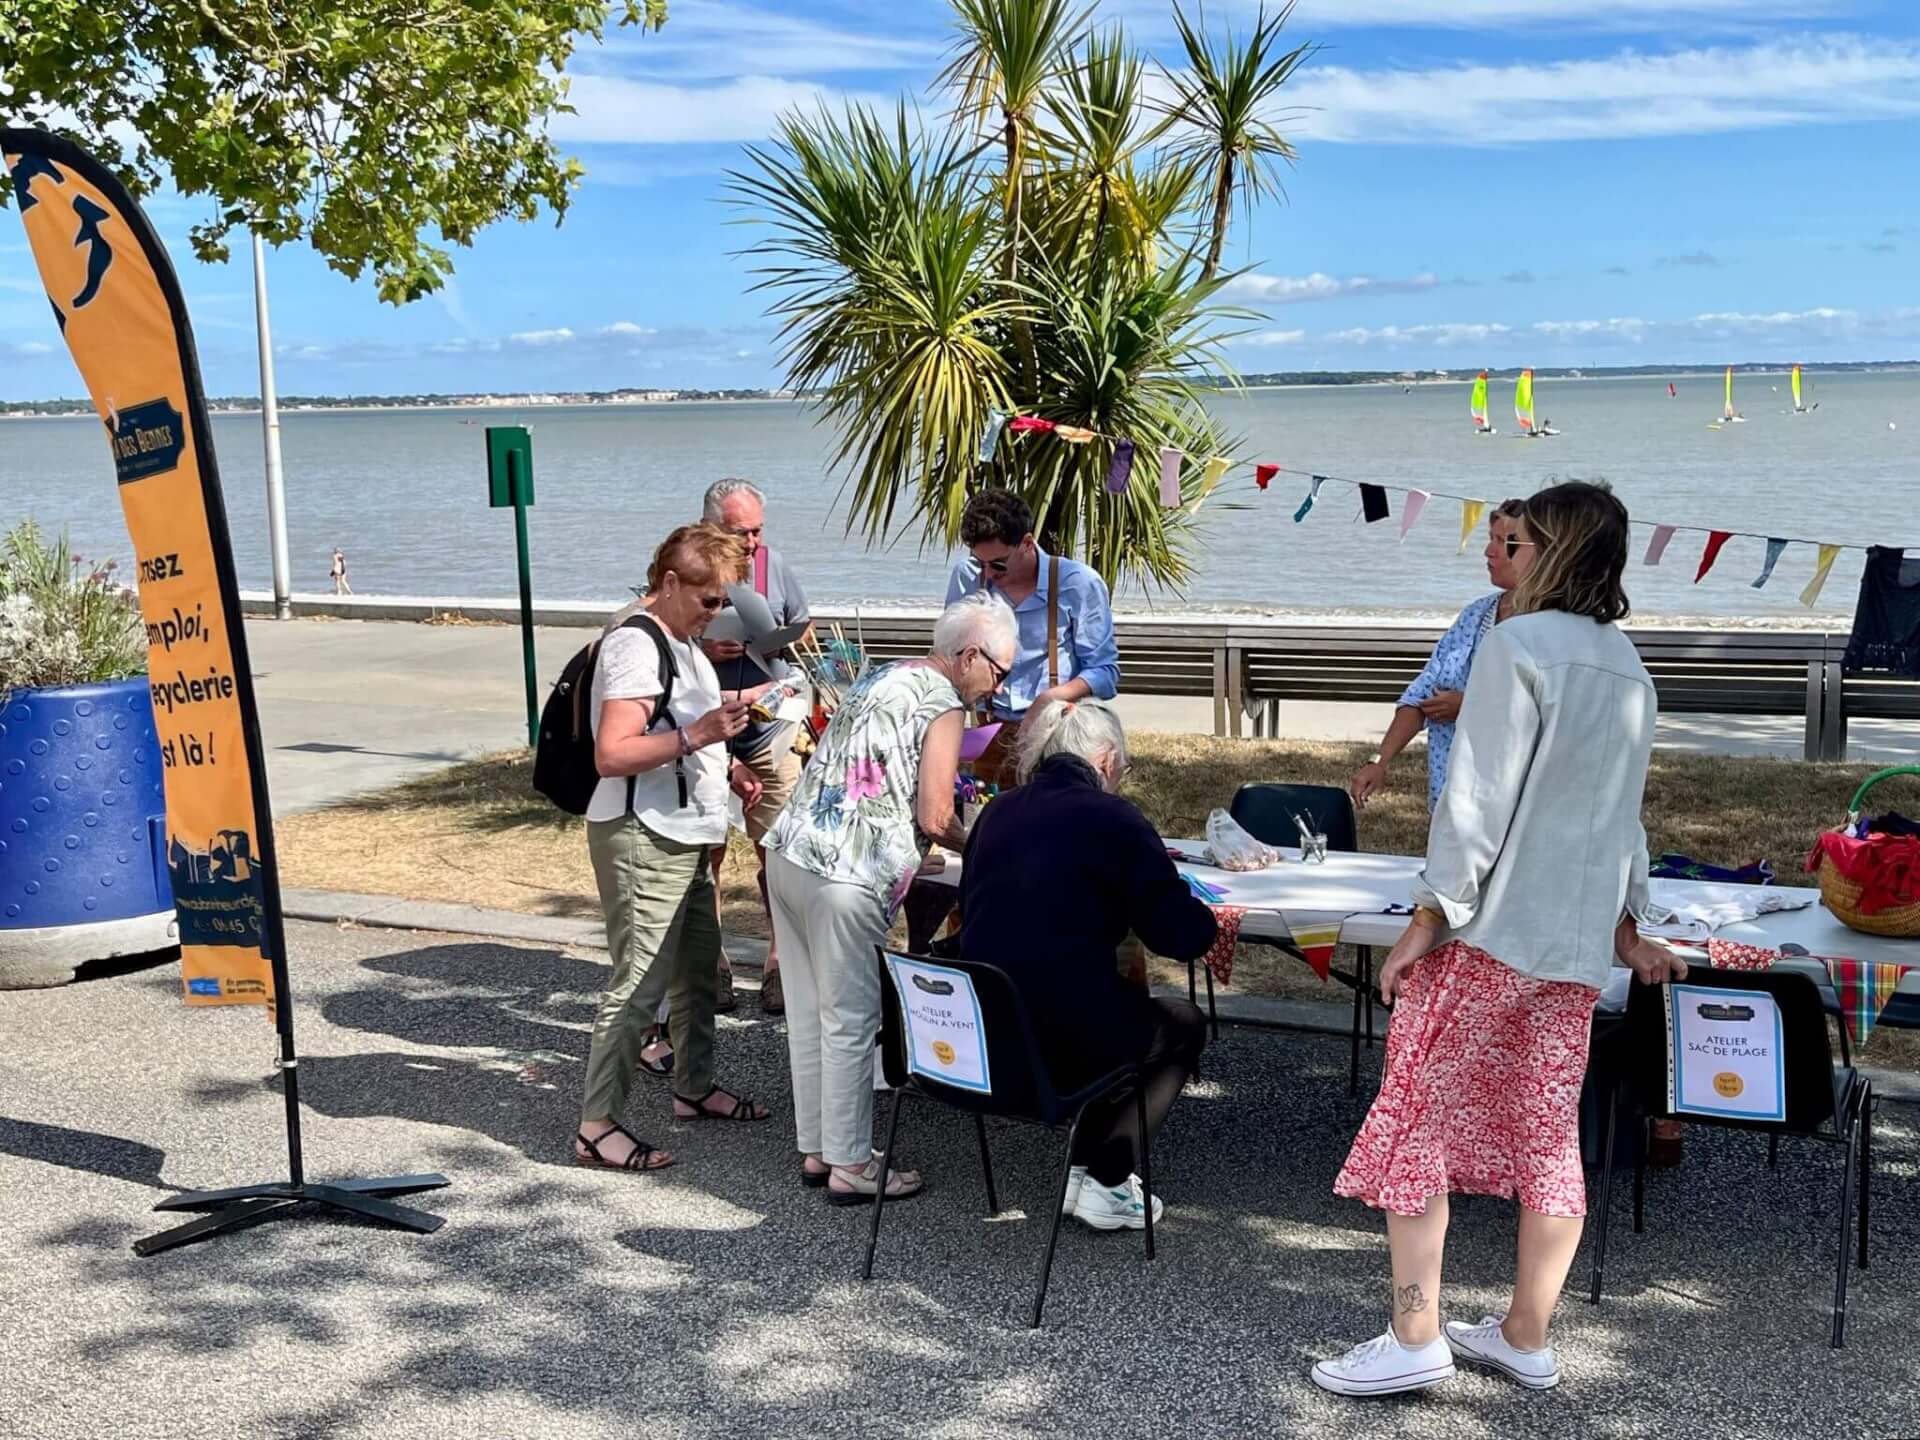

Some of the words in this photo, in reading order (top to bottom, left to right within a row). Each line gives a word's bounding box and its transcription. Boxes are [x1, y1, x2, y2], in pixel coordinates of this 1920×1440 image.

[179, 734, 203, 766] là
[922, 1006, 953, 1018] ATELIER
[950, 1021, 975, 1030] VENT
[1705, 1035, 1748, 1046] ATELIER
[1688, 1042, 1710, 1053] SAC
[1713, 1047, 1728, 1056] DE
[1732, 1048, 1768, 1057] PLAGE
